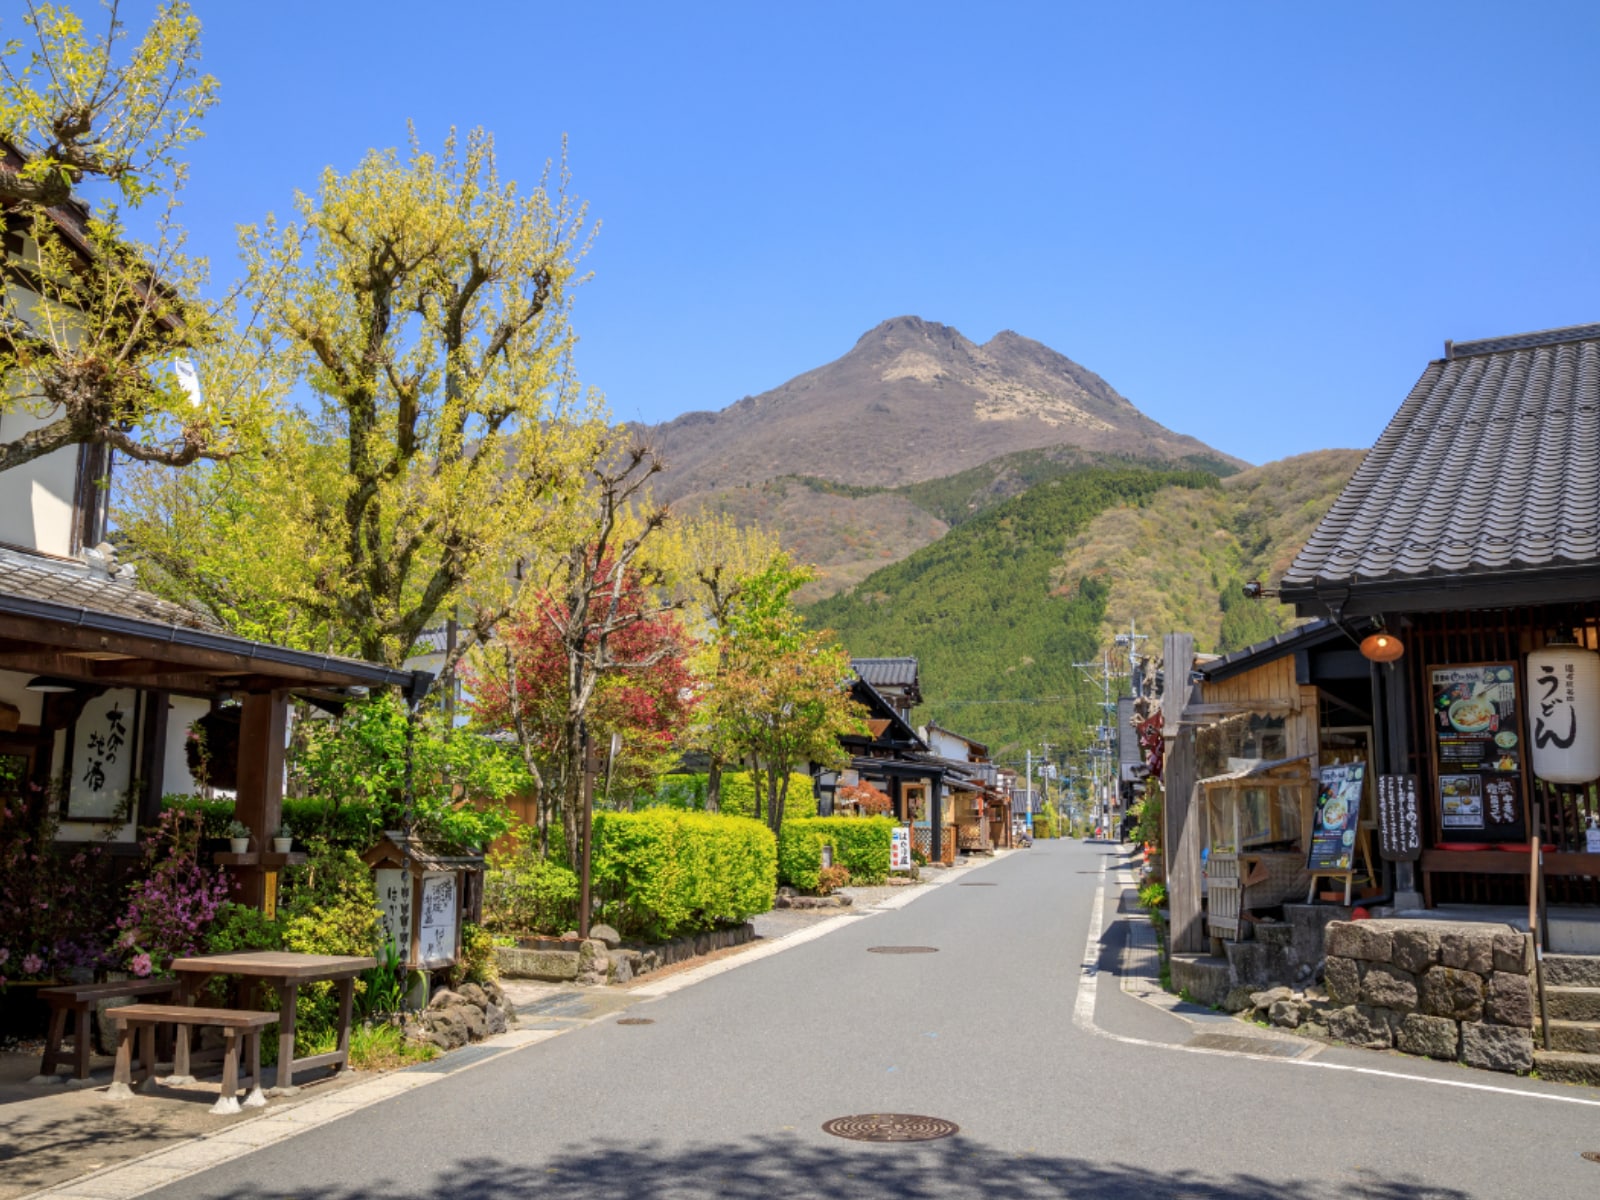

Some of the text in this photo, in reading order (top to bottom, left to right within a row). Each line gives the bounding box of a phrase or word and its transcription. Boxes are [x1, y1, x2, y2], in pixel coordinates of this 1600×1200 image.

[105, 701, 126, 764] 大分の
[1535, 665, 1577, 749] うどん
[82, 729, 105, 792] 地酒
